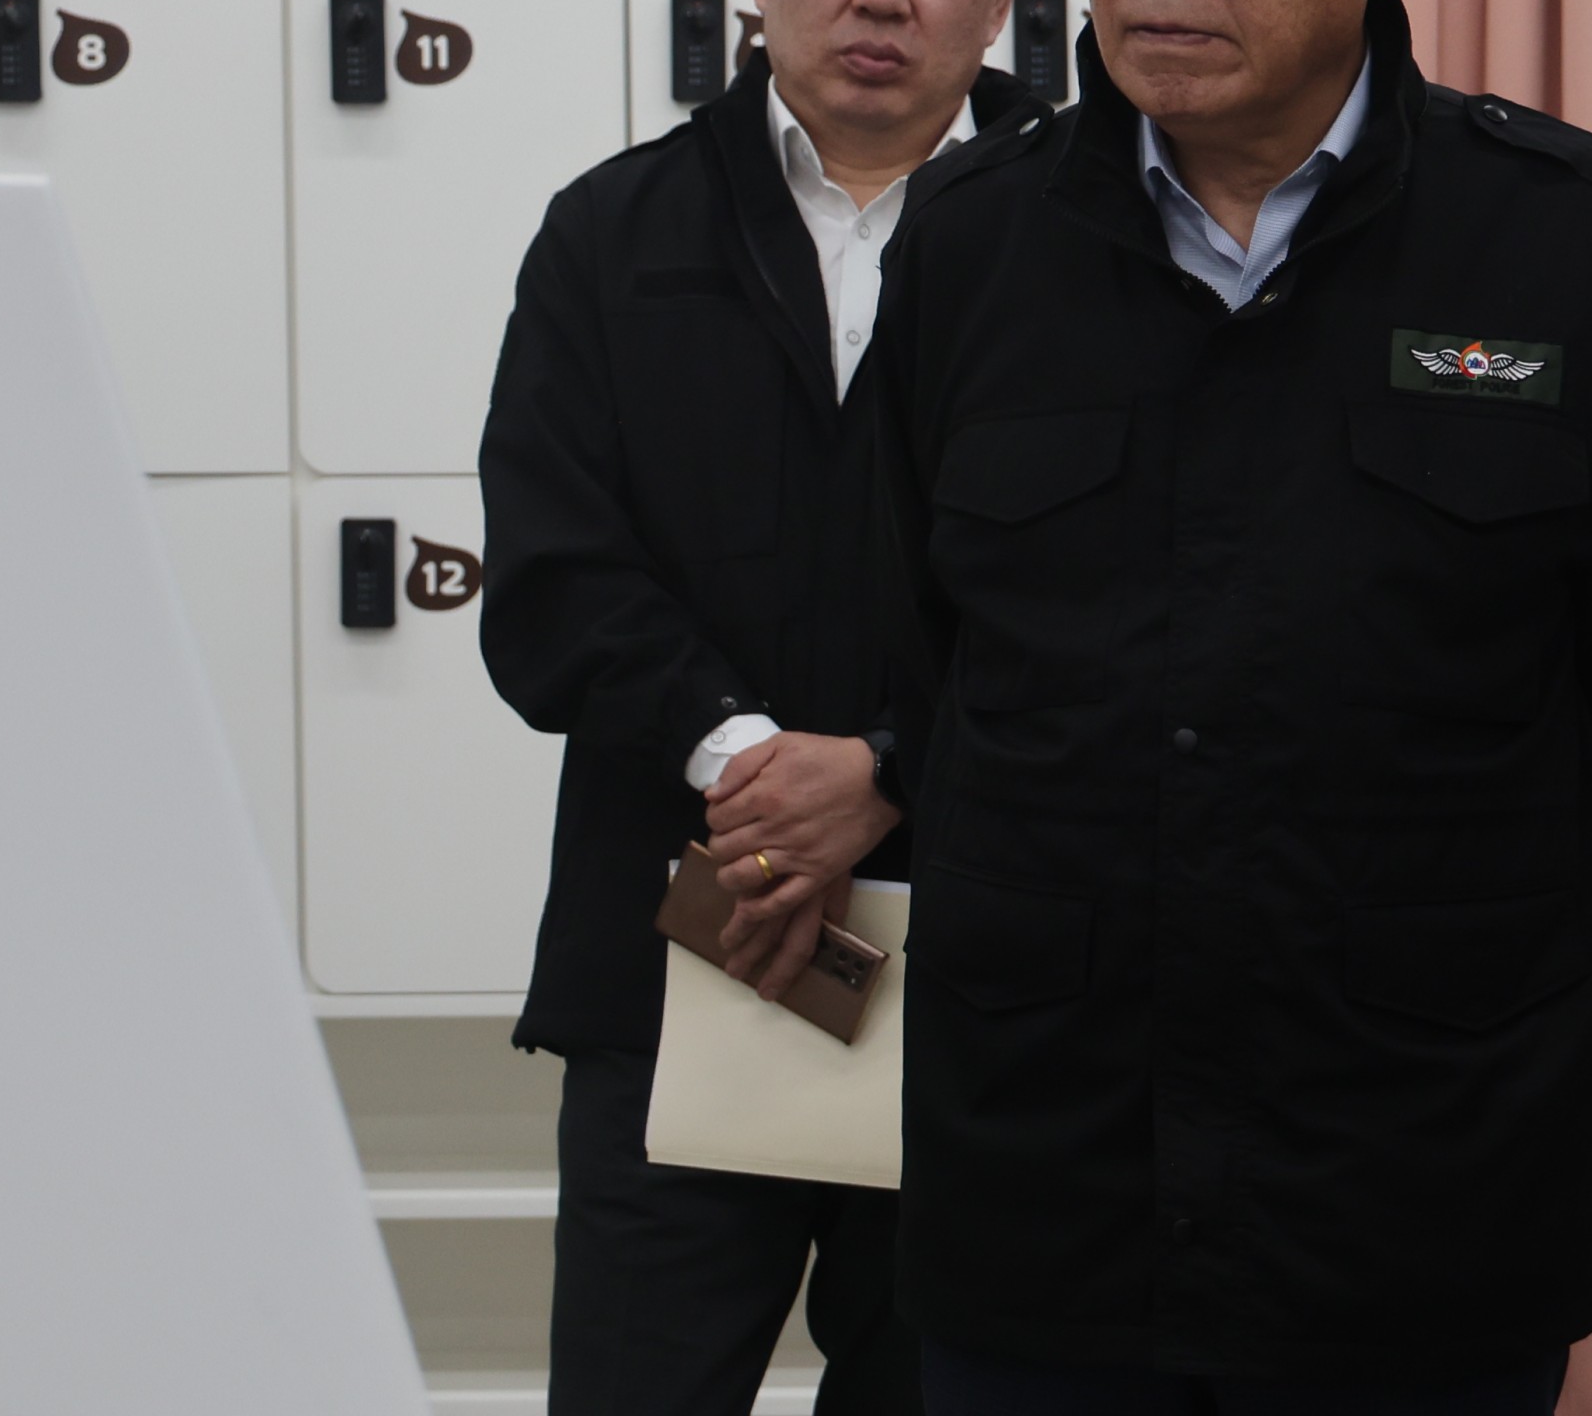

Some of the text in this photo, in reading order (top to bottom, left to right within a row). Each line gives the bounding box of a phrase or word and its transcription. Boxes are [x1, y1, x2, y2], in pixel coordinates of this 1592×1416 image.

[77, 33, 107, 71] 8
[416, 33, 450, 71] 11
[421, 559, 468, 597] 12
